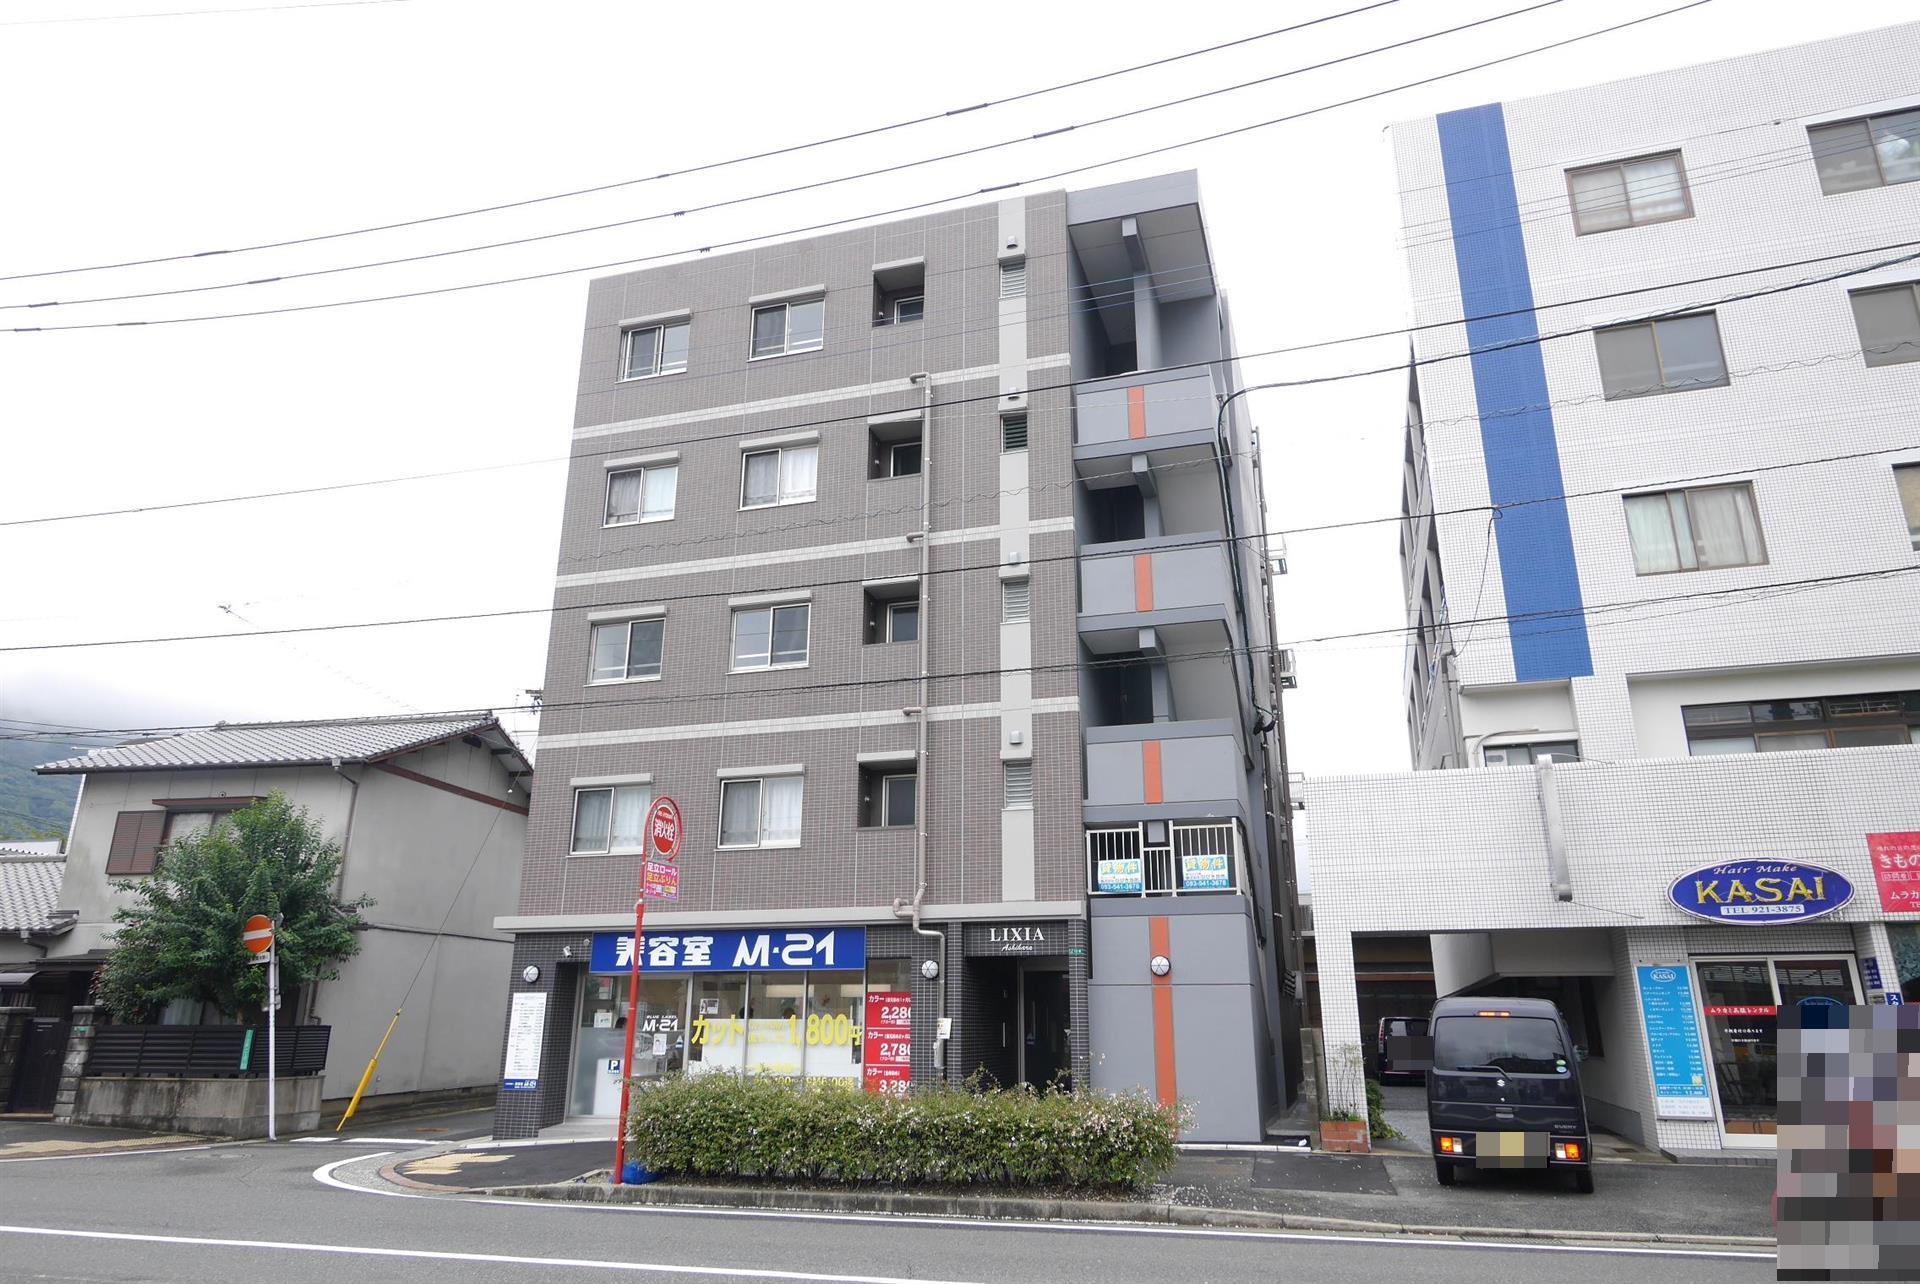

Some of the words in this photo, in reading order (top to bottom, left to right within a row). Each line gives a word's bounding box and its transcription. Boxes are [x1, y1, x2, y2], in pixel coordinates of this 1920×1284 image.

[1714, 864, 1751, 875] Hair
[1756, 863, 1798, 873] Make
[1694, 876, 1826, 904] KASAI
[1725, 906, 1747, 914] TEL
[1751, 905, 1802, 913] 921-3875
[989, 927, 1045, 942] LIXIA
[616, 936, 714, 967] 美容室
[869, 995, 885, 1003] カラー
[691, 1014, 745, 1046] カット
[867, 1031, 884, 1040] カラー
[866, 1067, 883, 1077] カラー
